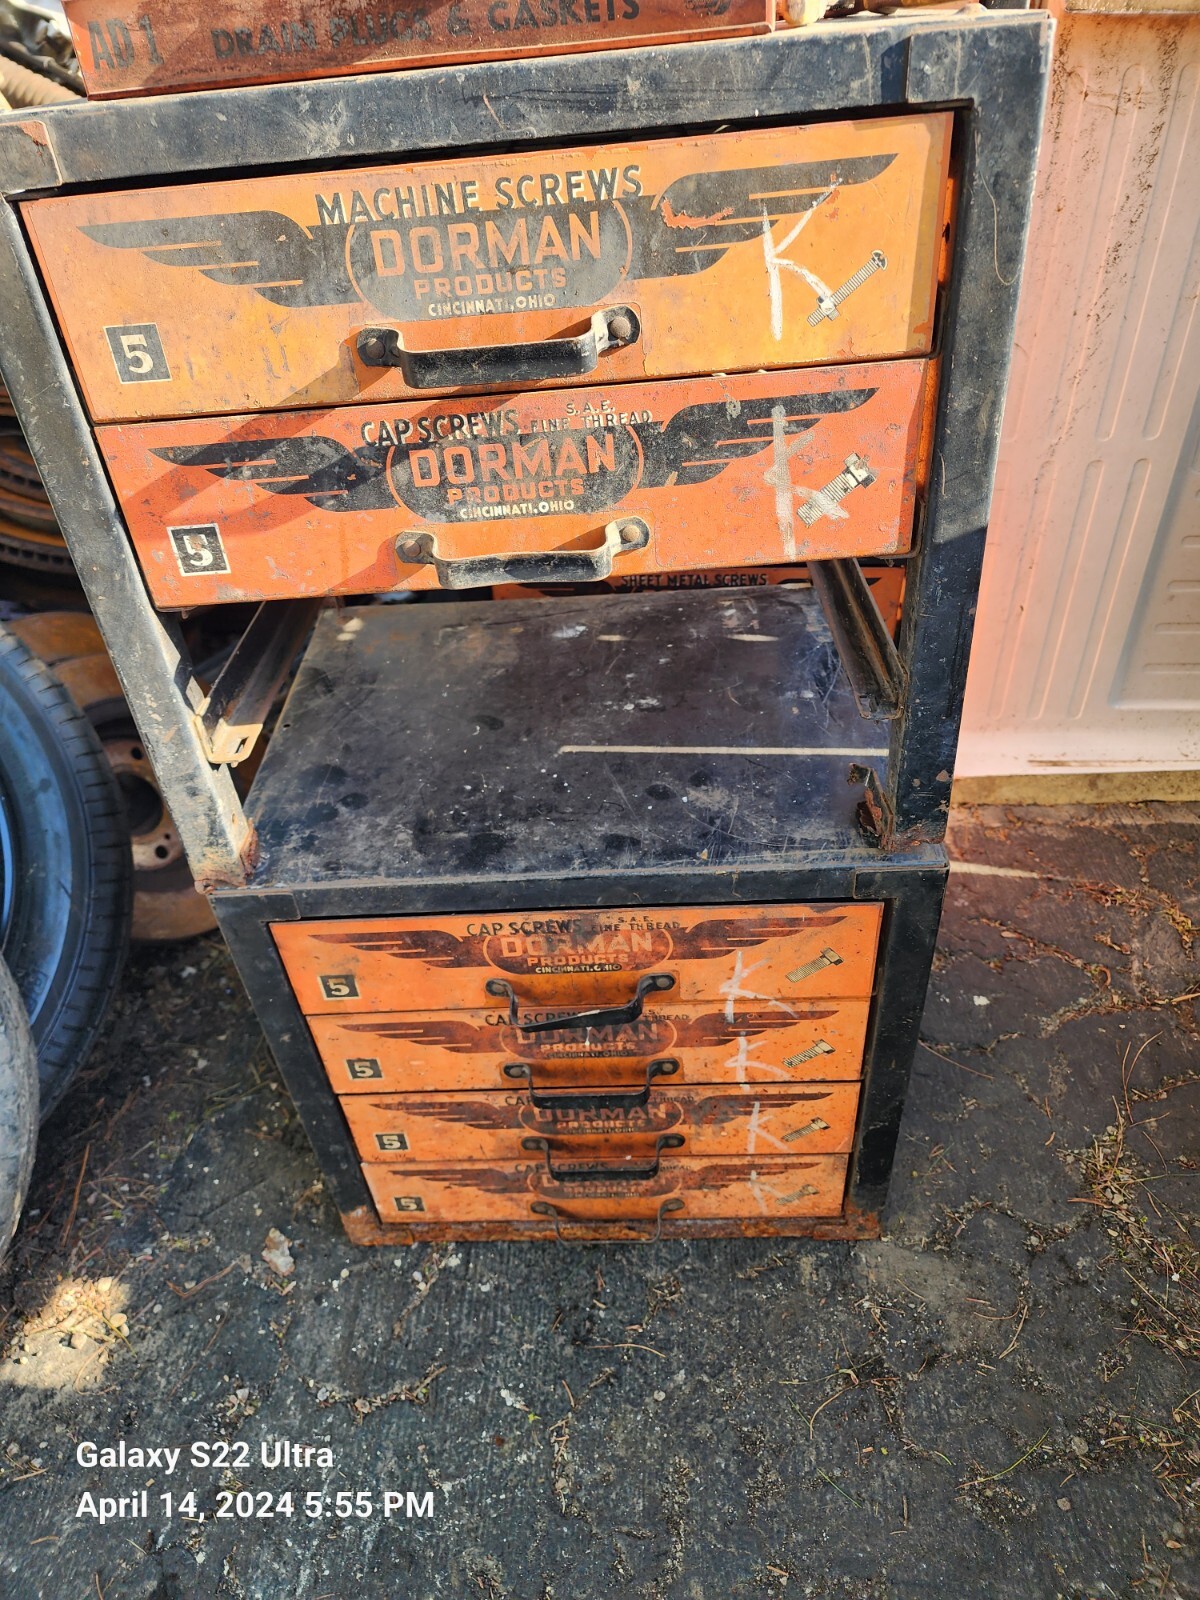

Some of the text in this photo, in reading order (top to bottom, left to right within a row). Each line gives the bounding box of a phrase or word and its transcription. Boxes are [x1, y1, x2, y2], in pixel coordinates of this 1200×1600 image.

[210, 0, 640, 60] DRAIN PLUGS & GASKETS
[315, 164, 645, 226] MACHINE SCREWS
[369, 211, 602, 278] DORMAN
[414, 266, 567, 300] PRODUCTS
[119, 333, 154, 374] 5
[580, 410, 653, 428] THREAD
[408, 433, 617, 488] DORMAN
[447, 477, 586, 506] PRODUCTS
[183, 534, 213, 567] 5
[620, 572, 767, 588] SHEET METAL SCREWS
[466, 922, 503, 937] CAP
[508, 918, 582, 936] SCREWS
[500, 932, 652, 958] DORMAN
[526, 953, 629, 967] PRODUCTS
[328, 979, 350, 996] 5
[540, 1041, 636, 1052] PRODUCTS
[354, 1062, 373, 1078] 5
[382, 1136, 400, 1149] 5
[401, 1199, 417, 1211] 5
